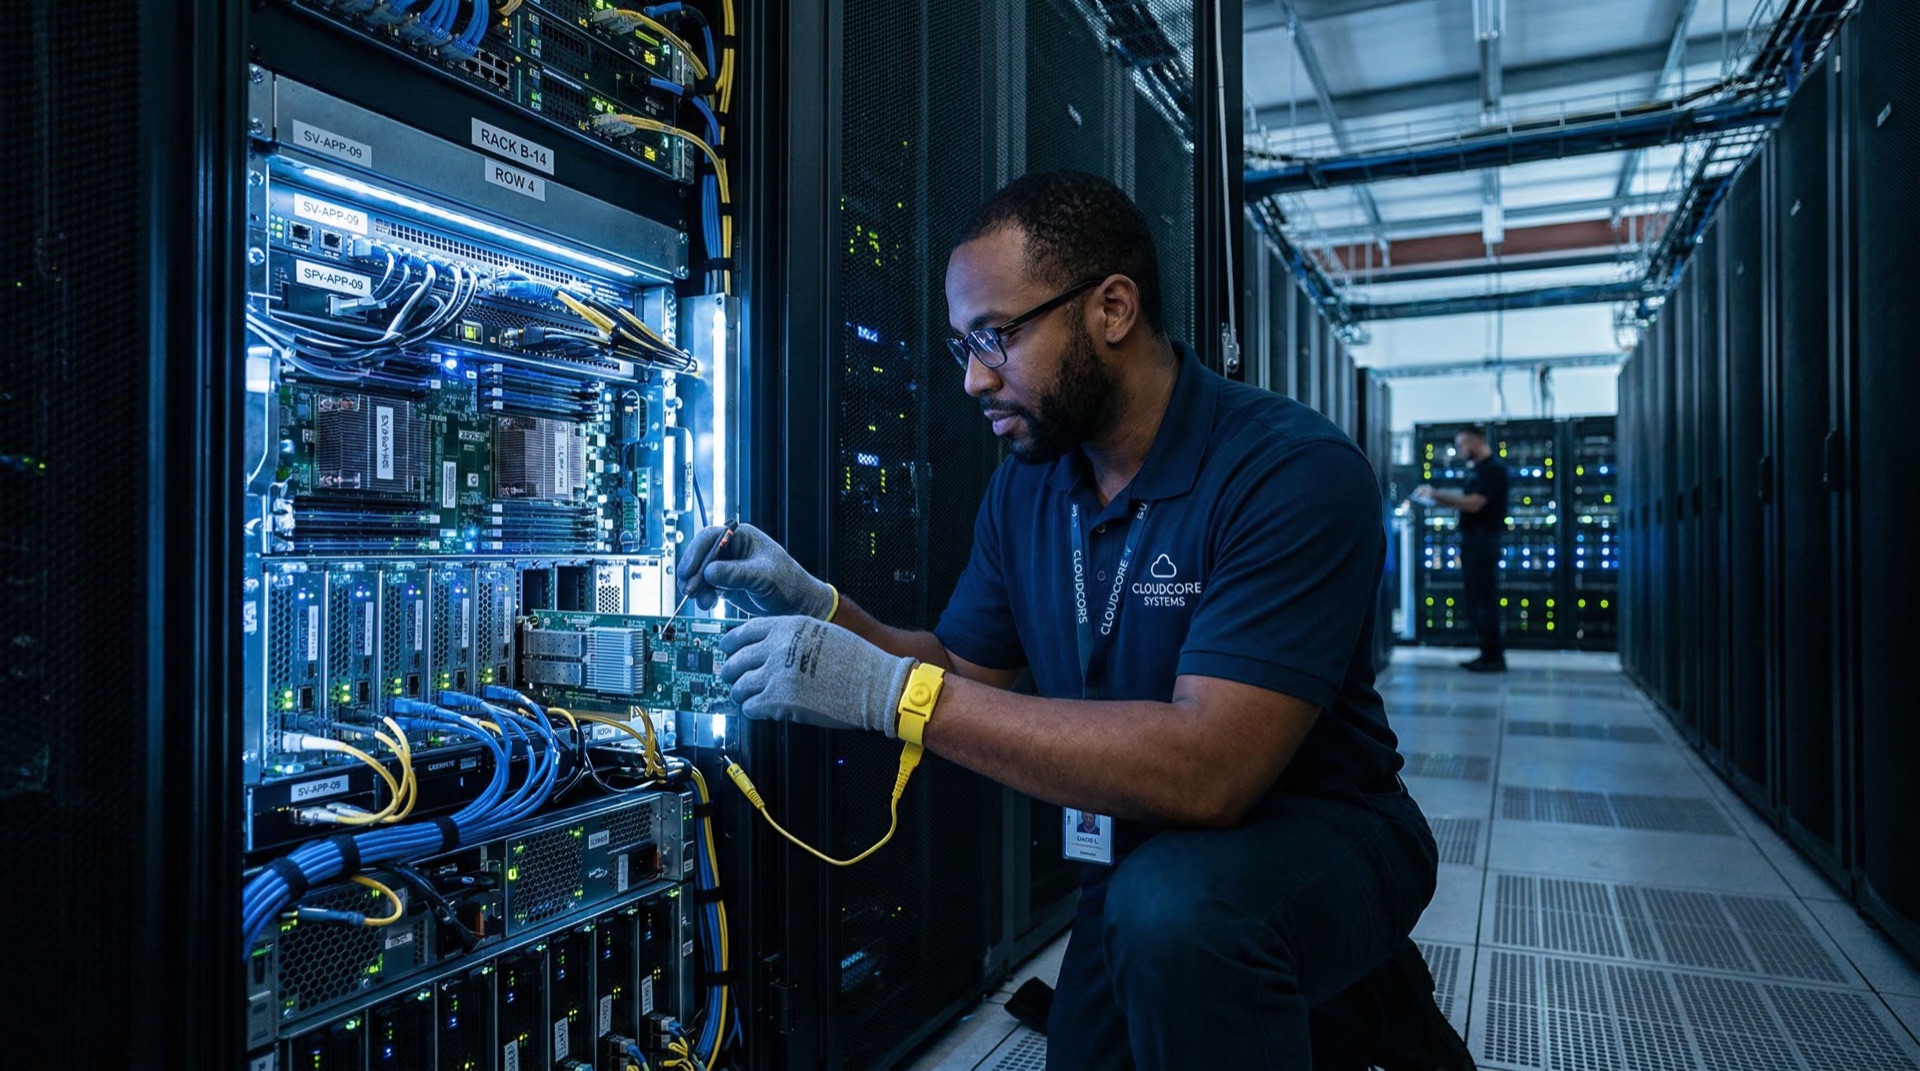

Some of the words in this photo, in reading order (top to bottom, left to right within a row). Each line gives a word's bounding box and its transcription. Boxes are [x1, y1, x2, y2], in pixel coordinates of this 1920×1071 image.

[304, 130, 362, 159] SV-APP-09
[481, 128, 518, 155] RACK
[520, 144, 547, 167] B-14
[495, 167, 526, 190] ROW
[528, 181, 535, 193] 4
[303, 201, 360, 226] SV-APP-09
[1100, 558, 1129, 636] CLOUDCORE
[1131, 582, 1202, 595] CLOUDCORE
[1143, 595, 1186, 607] SYSTEMS
[297, 780, 341, 797] SV-APP-09
